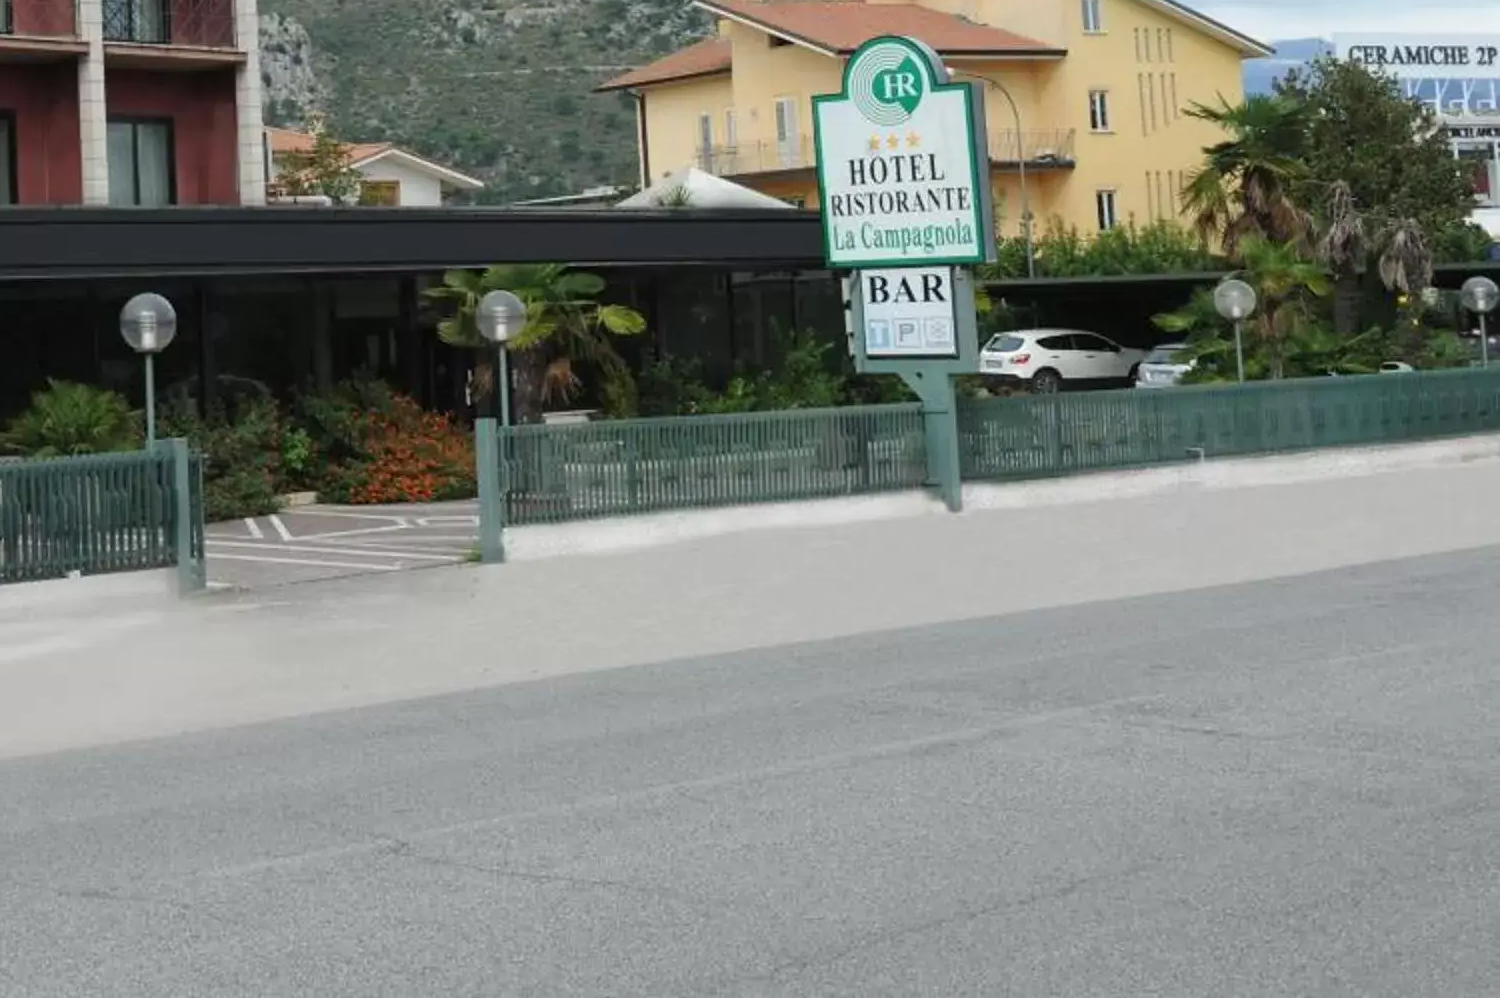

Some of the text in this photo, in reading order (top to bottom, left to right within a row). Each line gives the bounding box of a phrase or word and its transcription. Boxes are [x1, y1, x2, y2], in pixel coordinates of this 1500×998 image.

[1348, 45, 1498, 67] CERAMICHE 2P
[883, 72, 918, 99] HR
[848, 153, 945, 186] HOTEL
[831, 186, 971, 217] RISTORANTE
[833, 218, 974, 254] La Campagnola
[868, 273, 947, 304] BAR
[899, 323, 915, 342] P
